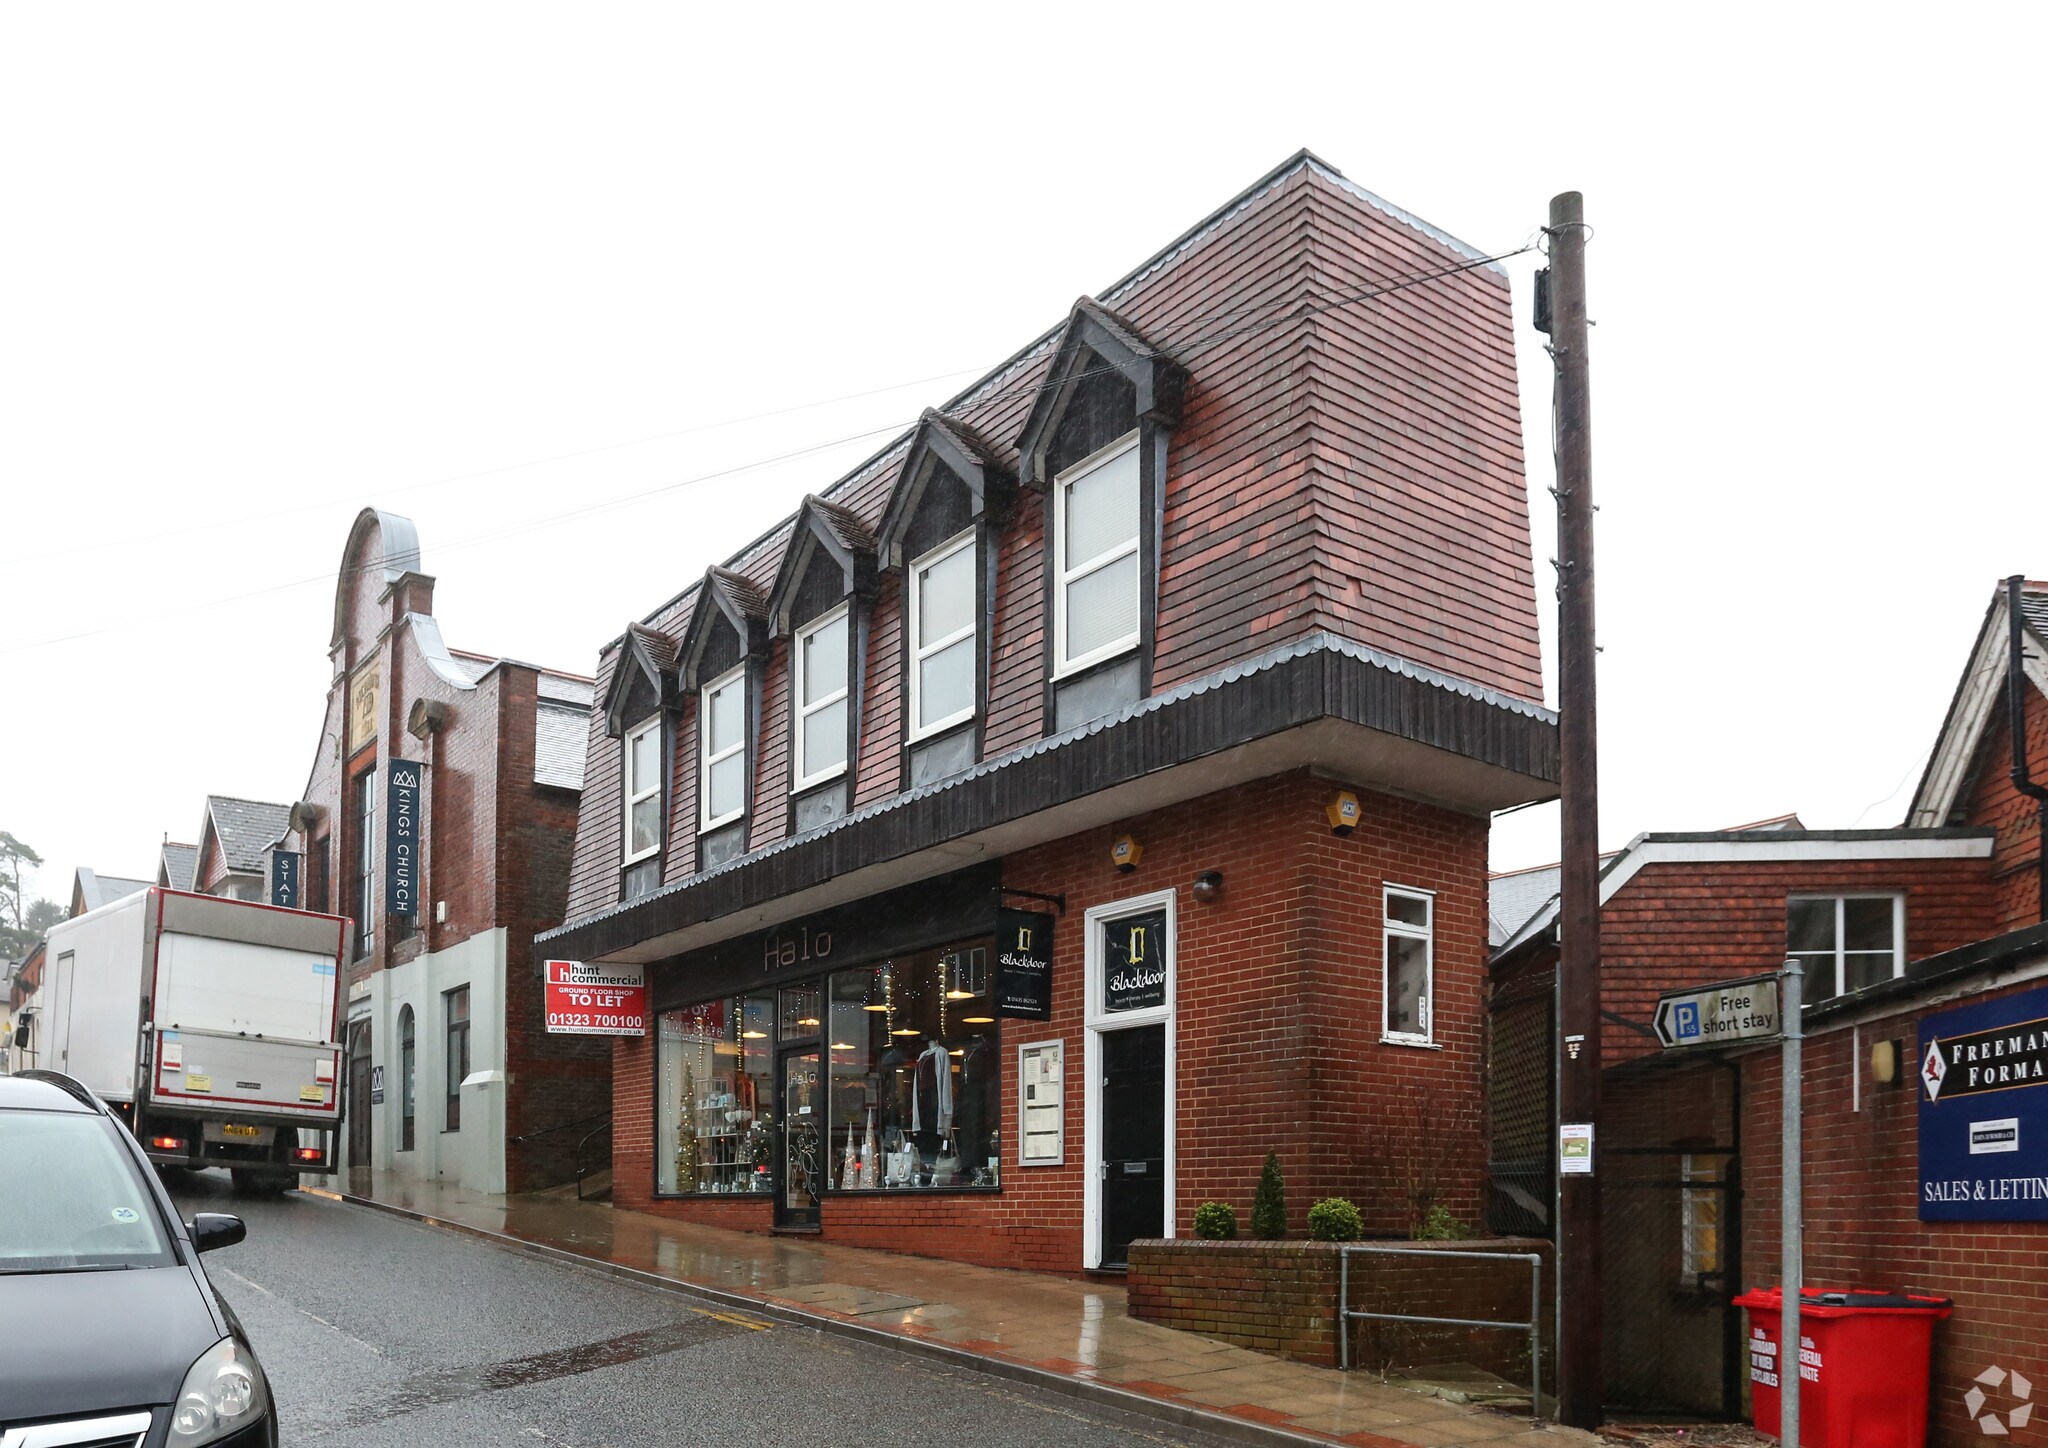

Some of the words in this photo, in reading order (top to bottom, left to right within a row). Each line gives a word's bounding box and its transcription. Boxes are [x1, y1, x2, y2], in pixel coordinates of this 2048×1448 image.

[398, 788, 411, 837] KINGS
[396, 844, 409, 911] CHURCH
[764, 926, 832, 972] Halo
[571, 964, 600, 975] hunt
[1000, 952, 1047, 969] Blackdoor
[571, 974, 642, 986] commercial
[1110, 968, 1166, 992] Blackdoor
[558, 986, 589, 994] GROUND
[568, 994, 592, 1006] TO
[597, 995, 624, 1007] LET
[1721, 996, 1750, 1012] Free
[549, 1012, 590, 1026] 01323
[593, 1014, 642, 1028] 700100
[1703, 1015, 1739, 1034] short
[1743, 1012, 1773, 1029] stay
[1968, 1059, 2048, 1087] FORMA
[1925, 1180, 1970, 1201] SALES
[1973, 1180, 1986, 1200] &
[1799, 1348, 1823, 1367] ENERAL
